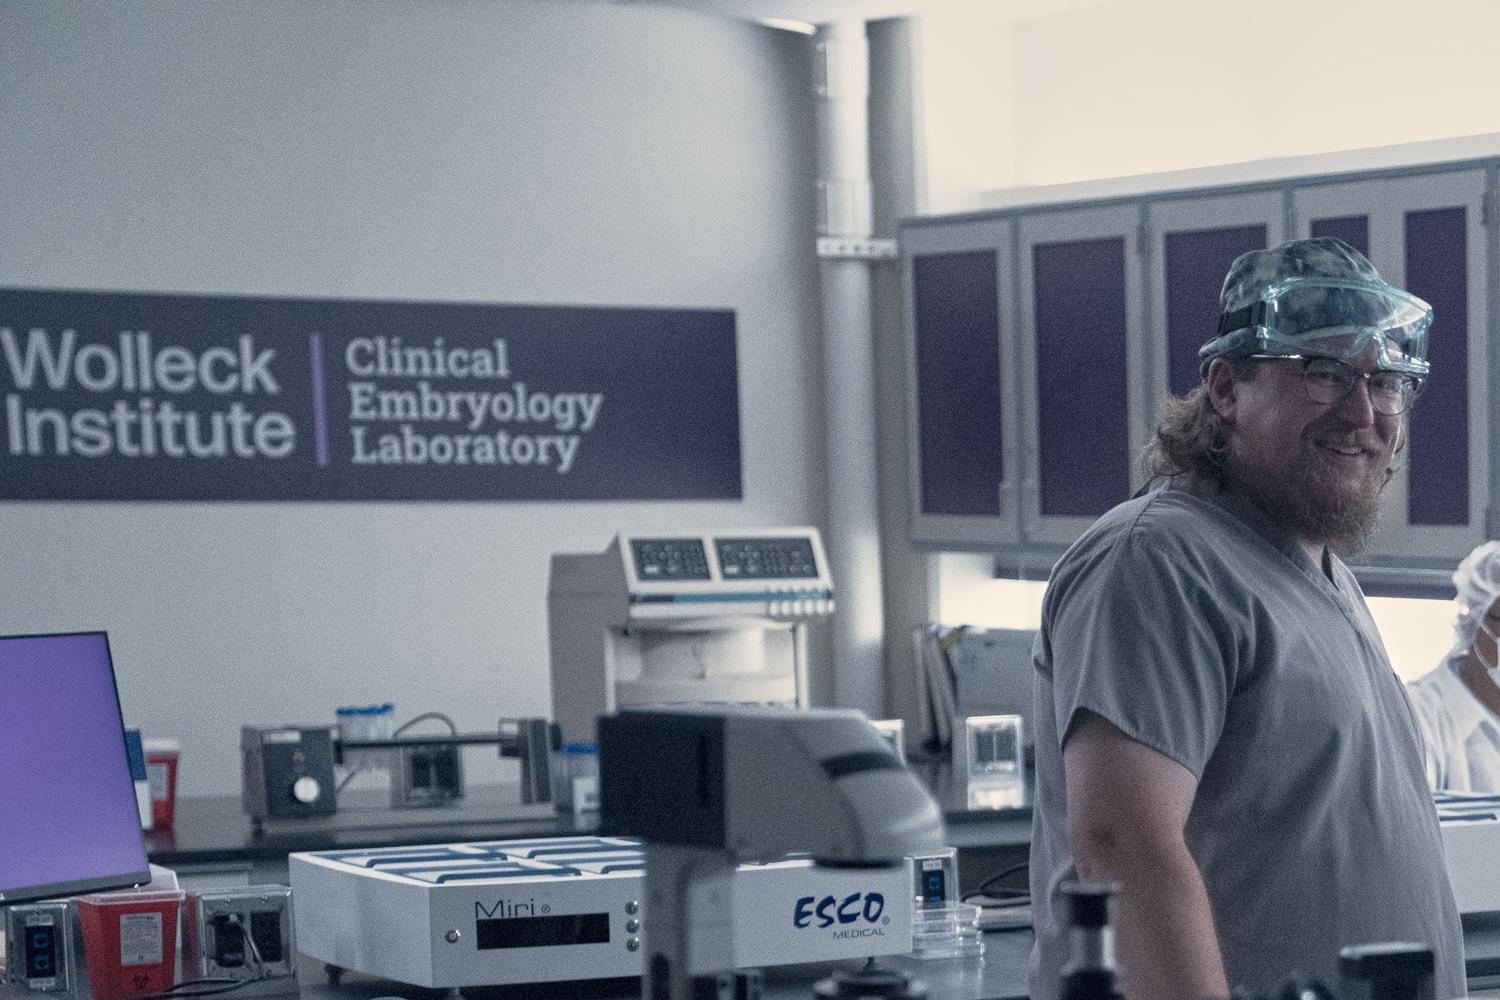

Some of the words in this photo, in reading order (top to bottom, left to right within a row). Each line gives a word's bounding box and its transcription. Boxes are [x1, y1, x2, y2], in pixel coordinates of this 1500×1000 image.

[0, 326, 279, 395] Wolleck
[345, 335, 511, 379] Clinical
[5, 393, 296, 457] Institute
[348, 380, 604, 432] Embryology
[350, 424, 581, 475] Laboratory
[475, 898, 534, 918] Miri
[793, 892, 884, 929] ESCO
[832, 928, 885, 940] MEDICAL
